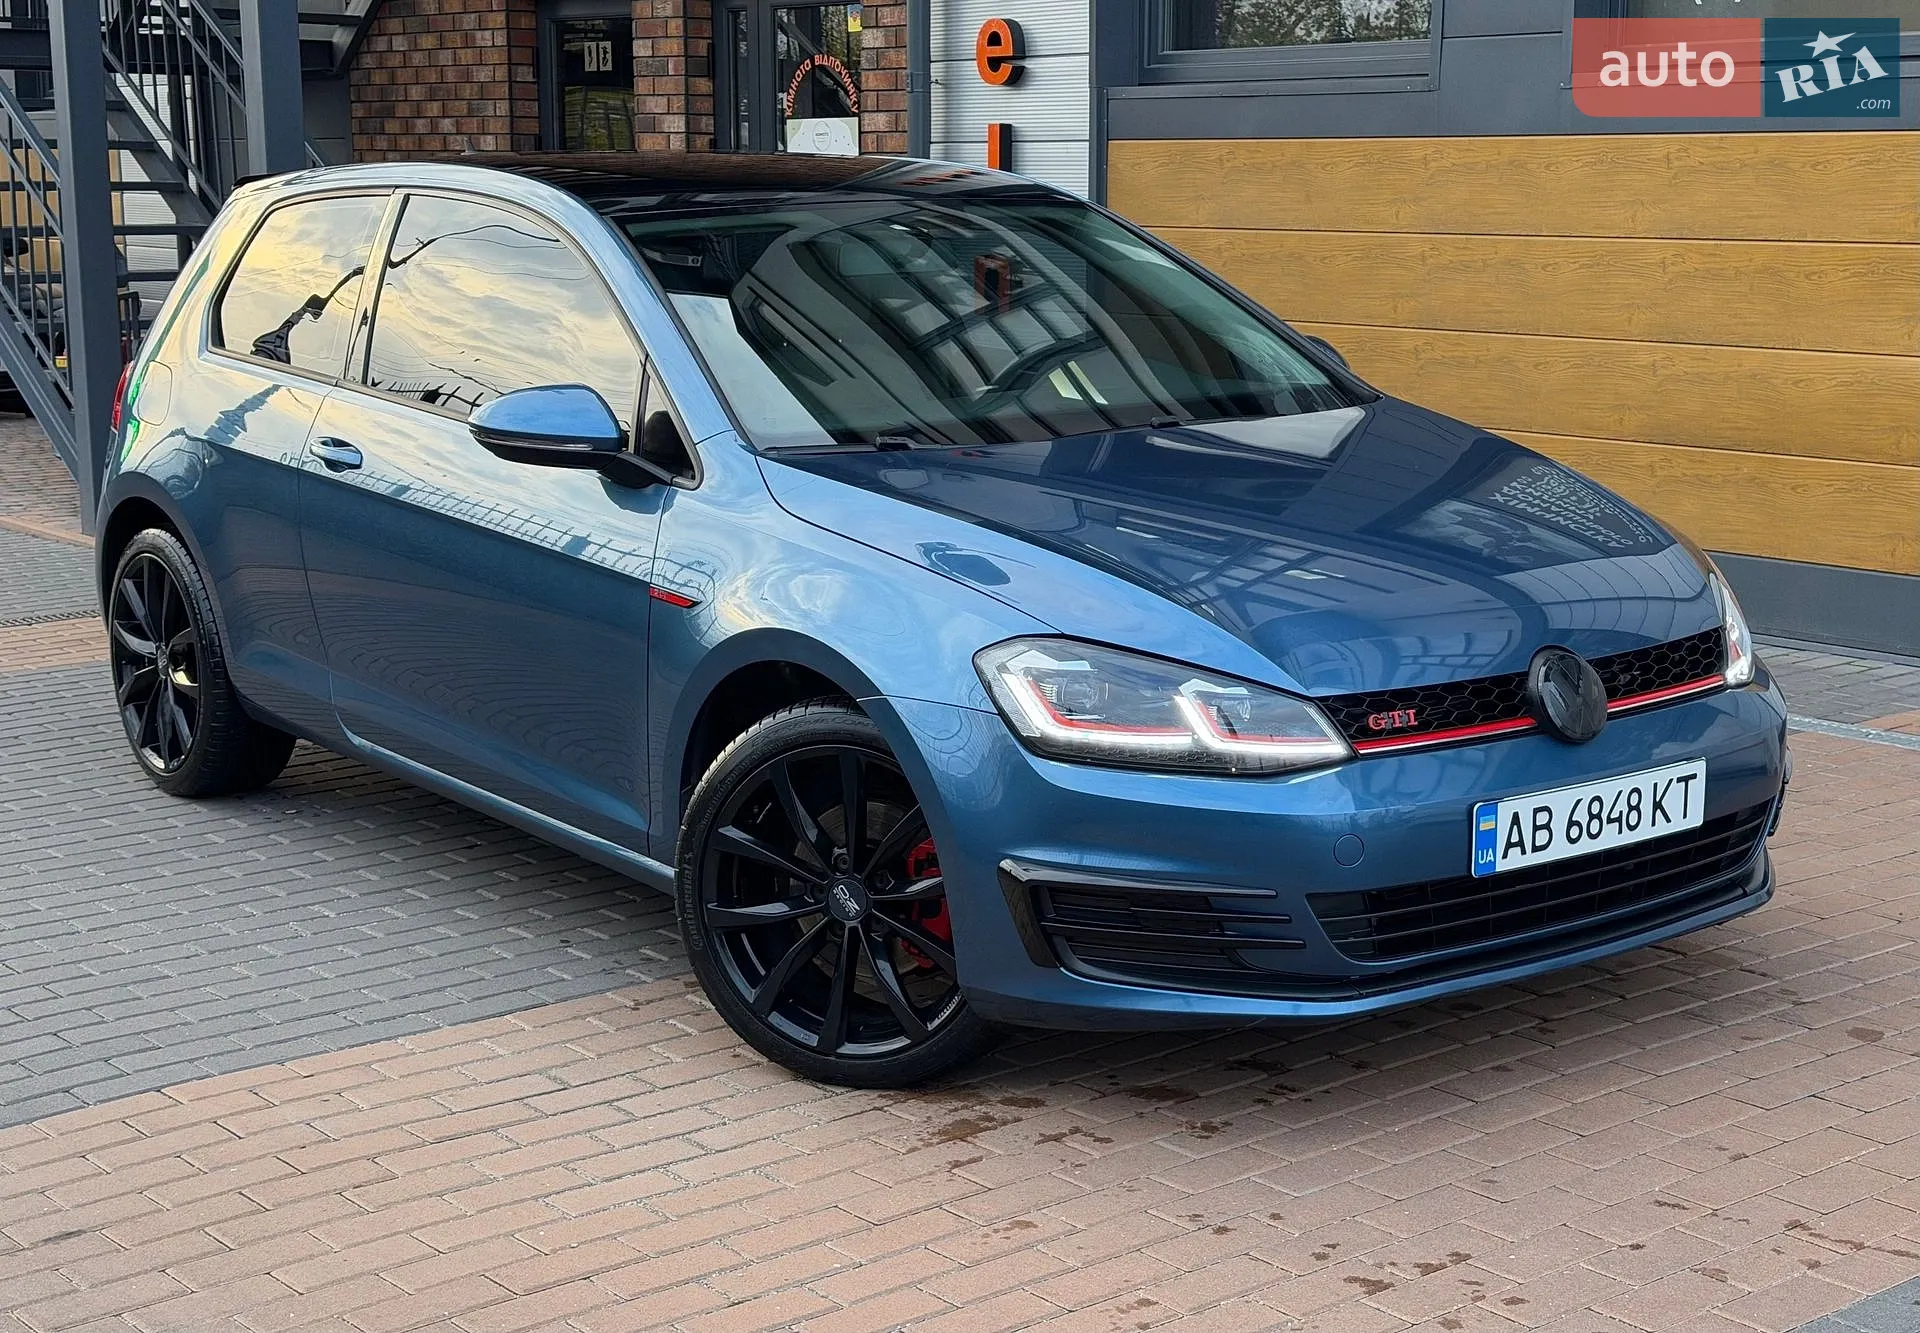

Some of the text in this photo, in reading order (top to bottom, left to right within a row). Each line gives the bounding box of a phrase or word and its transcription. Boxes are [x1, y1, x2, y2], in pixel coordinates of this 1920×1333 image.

[814, 54, 859, 114] ВІДПОЧИНКУ
[1367, 709, 1418, 730] GTI
[1502, 773, 1698, 860] AB 6848 KT
[1478, 848, 1495, 865] UA
